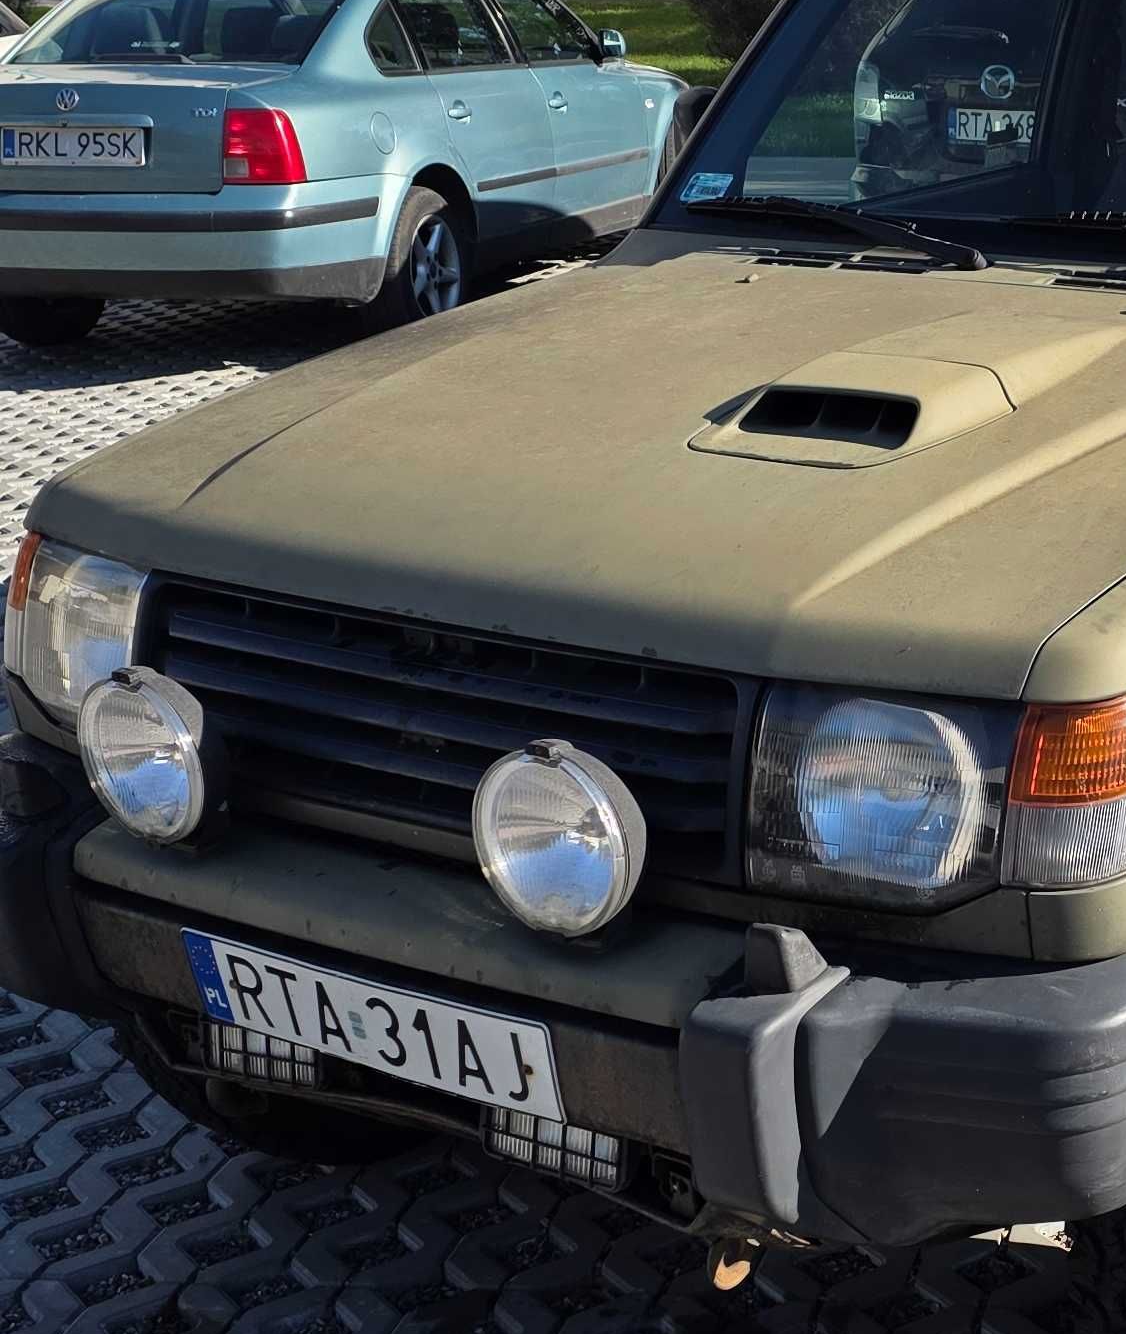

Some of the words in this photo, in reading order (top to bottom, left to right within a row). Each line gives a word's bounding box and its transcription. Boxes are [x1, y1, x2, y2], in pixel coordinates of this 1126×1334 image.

[958, 112, 992, 138] RTA
[18, 132, 67, 157] RKL
[78, 132, 137, 158] 95SK
[207, 987, 228, 1009] PL
[226, 953, 352, 1053] RTA
[366, 997, 530, 1103] 31AJ
